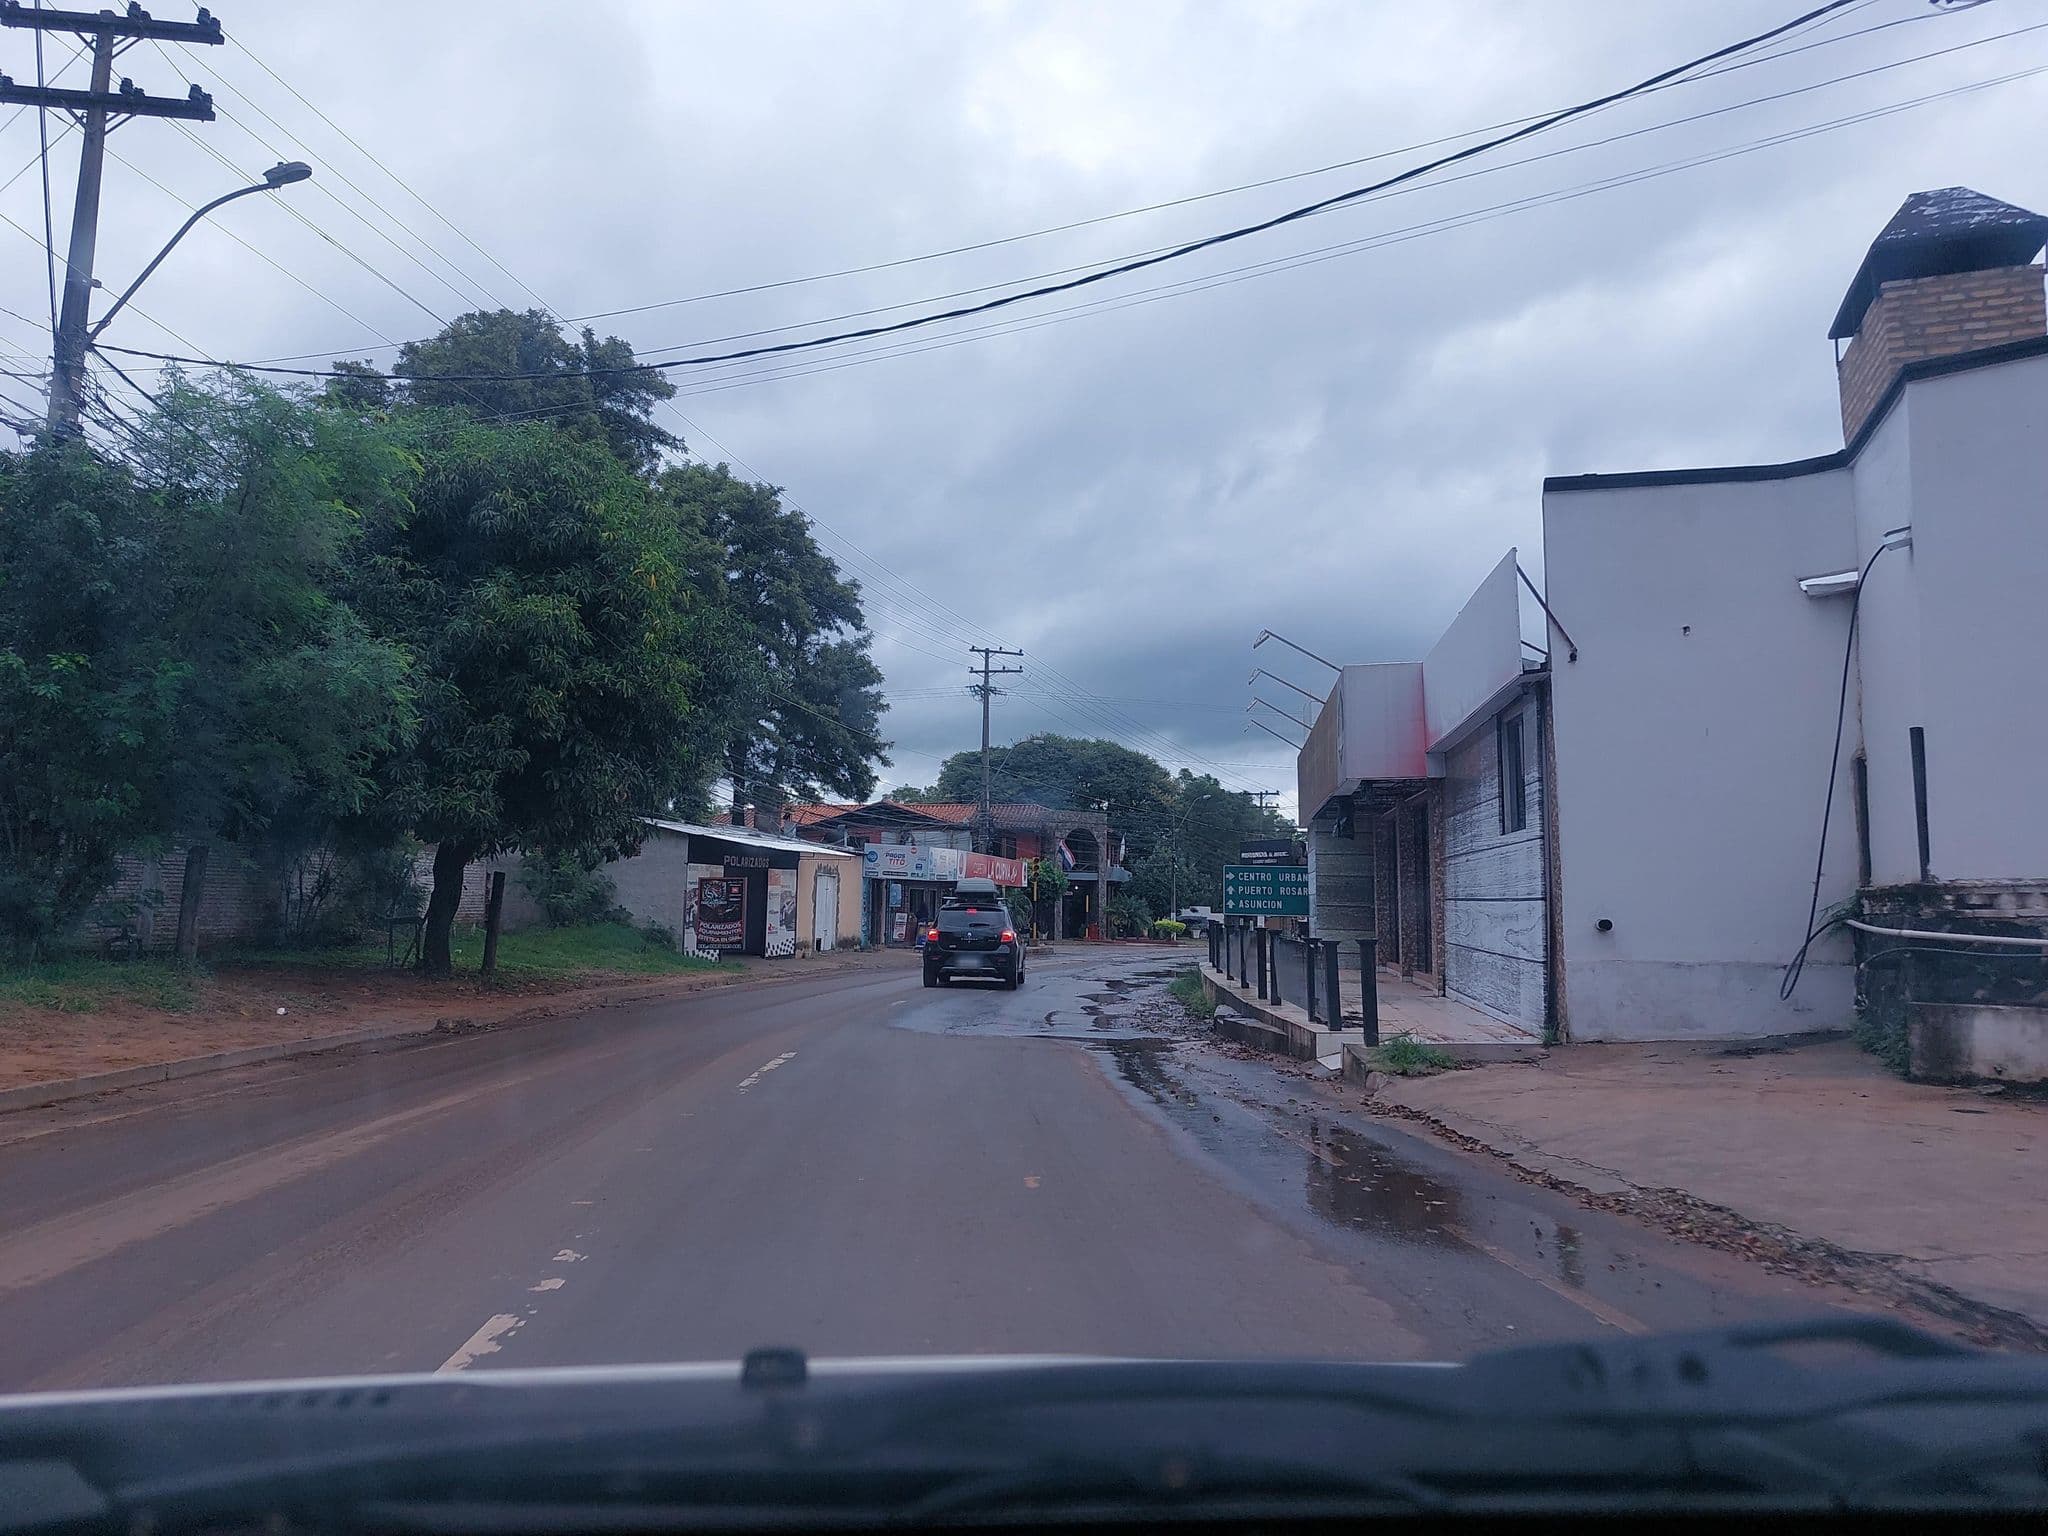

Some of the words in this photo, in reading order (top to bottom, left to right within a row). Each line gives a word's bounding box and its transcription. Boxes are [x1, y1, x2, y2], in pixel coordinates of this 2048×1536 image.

[724, 855, 769, 868] POLARIZADOS
[987, 860, 995, 879] LA
[1238, 872, 1272, 881] CENTRO
[1238, 886, 1273, 895] PUERTO
[1238, 900, 1283, 909] ASUNCION
[700, 921, 742, 930] POLARIZADOS
